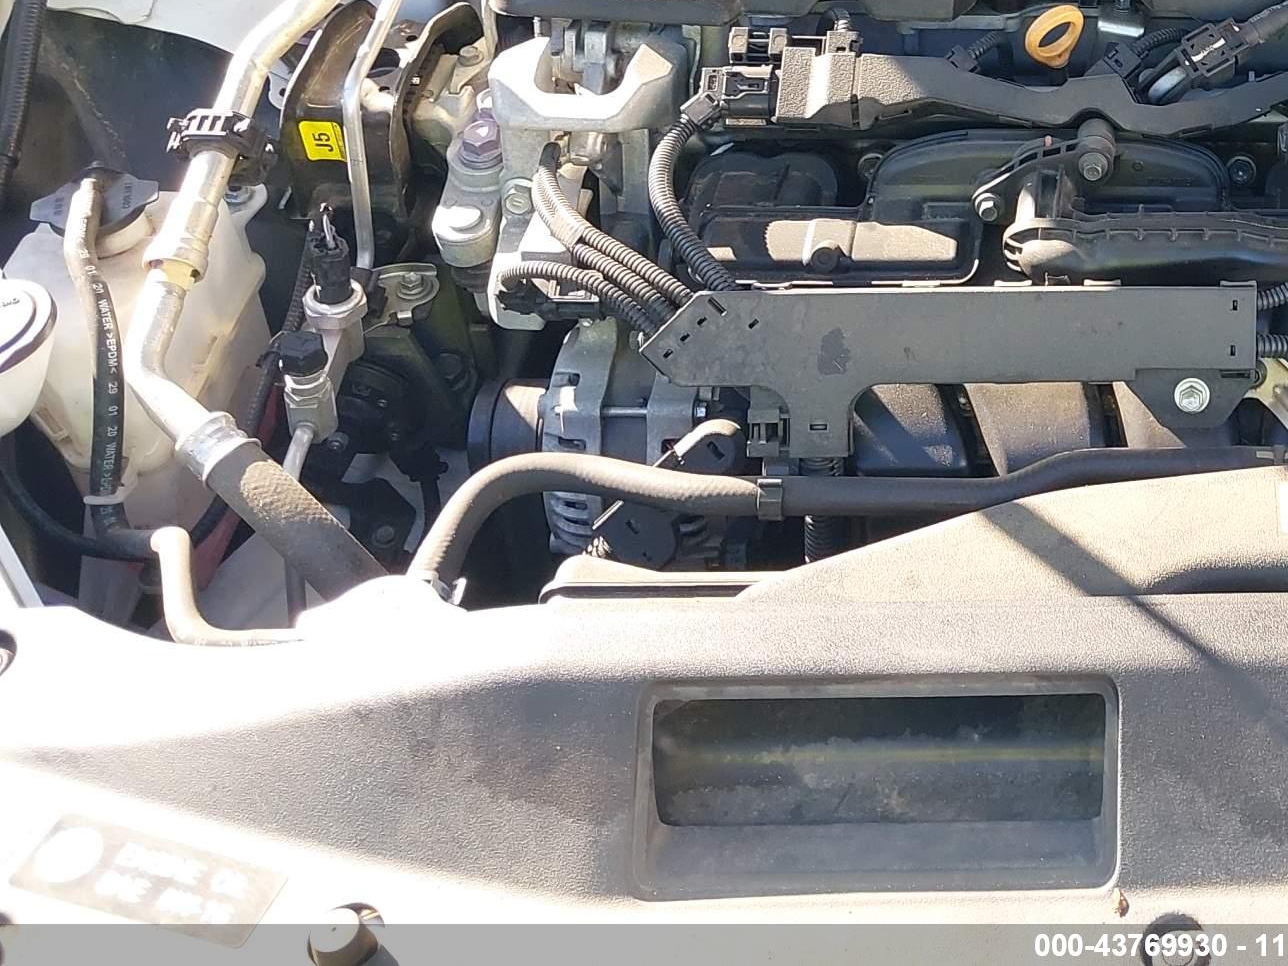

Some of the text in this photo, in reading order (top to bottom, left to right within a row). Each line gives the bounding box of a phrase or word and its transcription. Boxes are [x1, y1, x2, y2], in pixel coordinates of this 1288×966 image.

[311, 132, 334, 152] J5
[98, 298, 114, 331] WATER
[108, 382, 118, 394] 29
[108, 405, 119, 416] 01
[106, 426, 118, 437] 20
[103, 442, 118, 470] WATER
